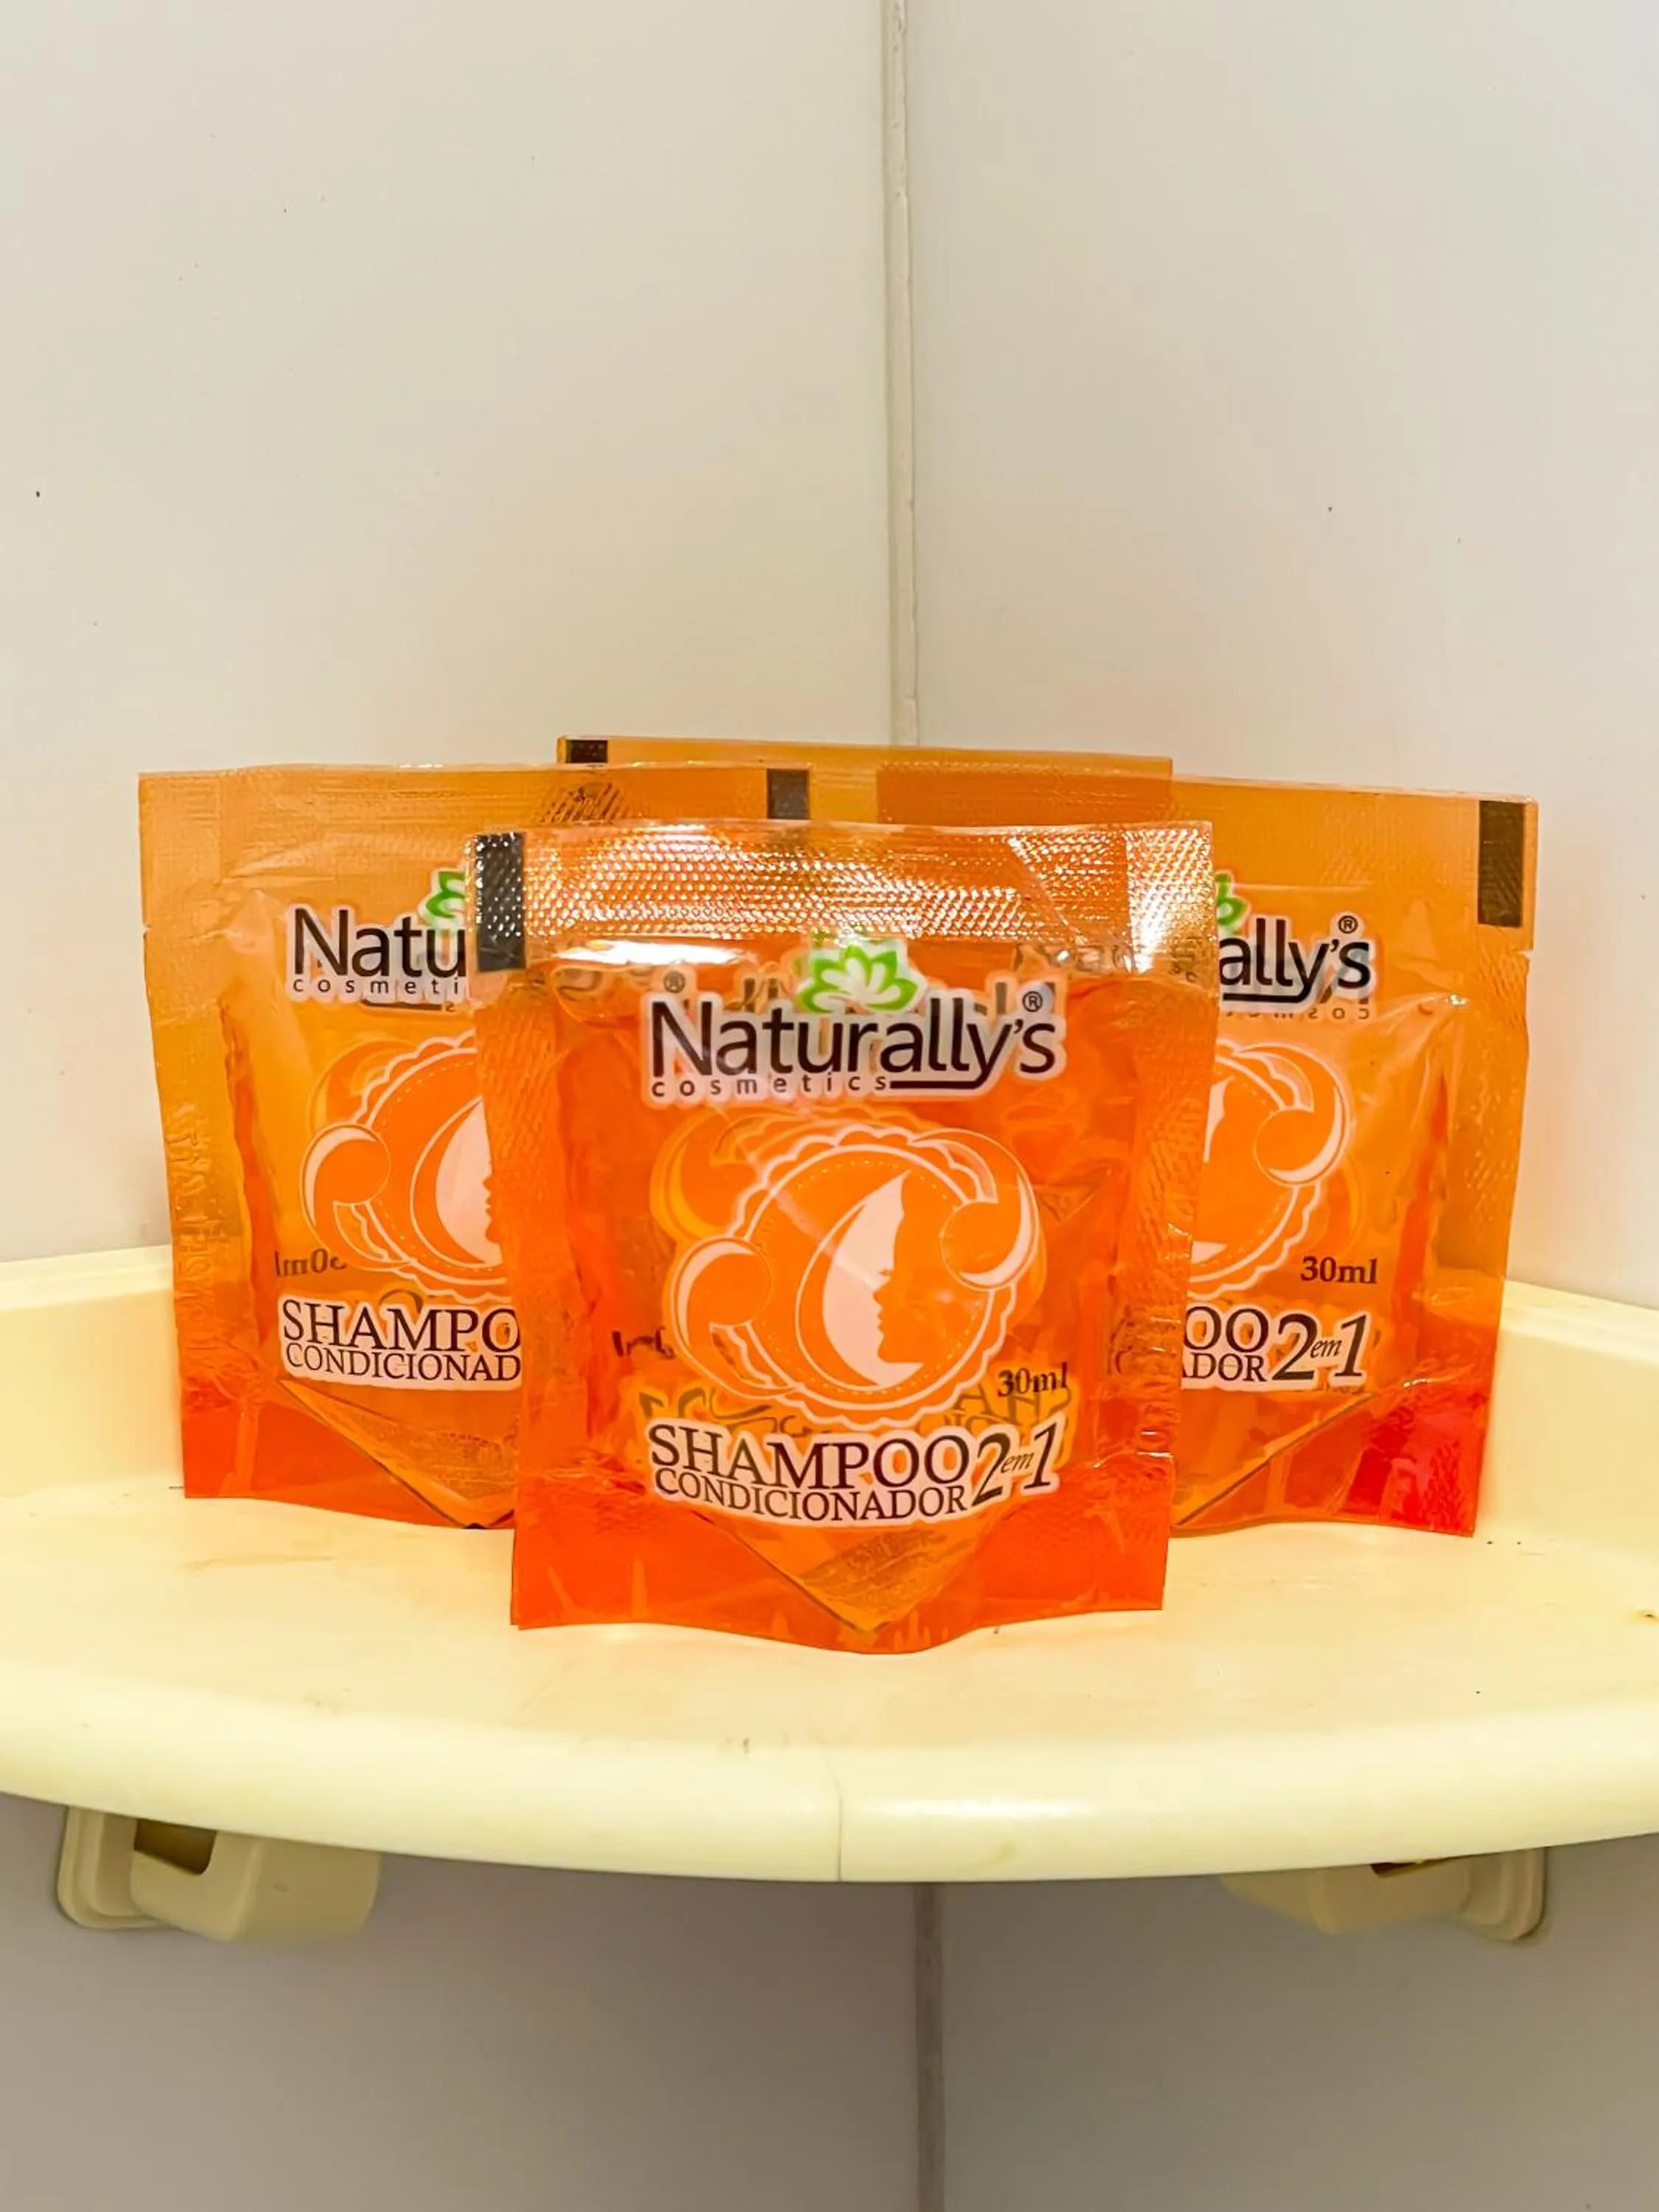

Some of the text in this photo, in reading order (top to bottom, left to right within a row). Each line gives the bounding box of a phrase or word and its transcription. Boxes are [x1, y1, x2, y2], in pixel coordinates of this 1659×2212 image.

[652, 997, 1057, 1089] Naturally's
[652, 1072, 887, 1098] cosmetics
[1300, 1256, 1377, 1284] 30ml
[997, 1362, 1068, 1398] 30ml
[1182, 1352, 1267, 1382] DOR
[648, 1425, 970, 1491] SHAMPOO
[655, 1467, 968, 1522] CONDICIONADOR
